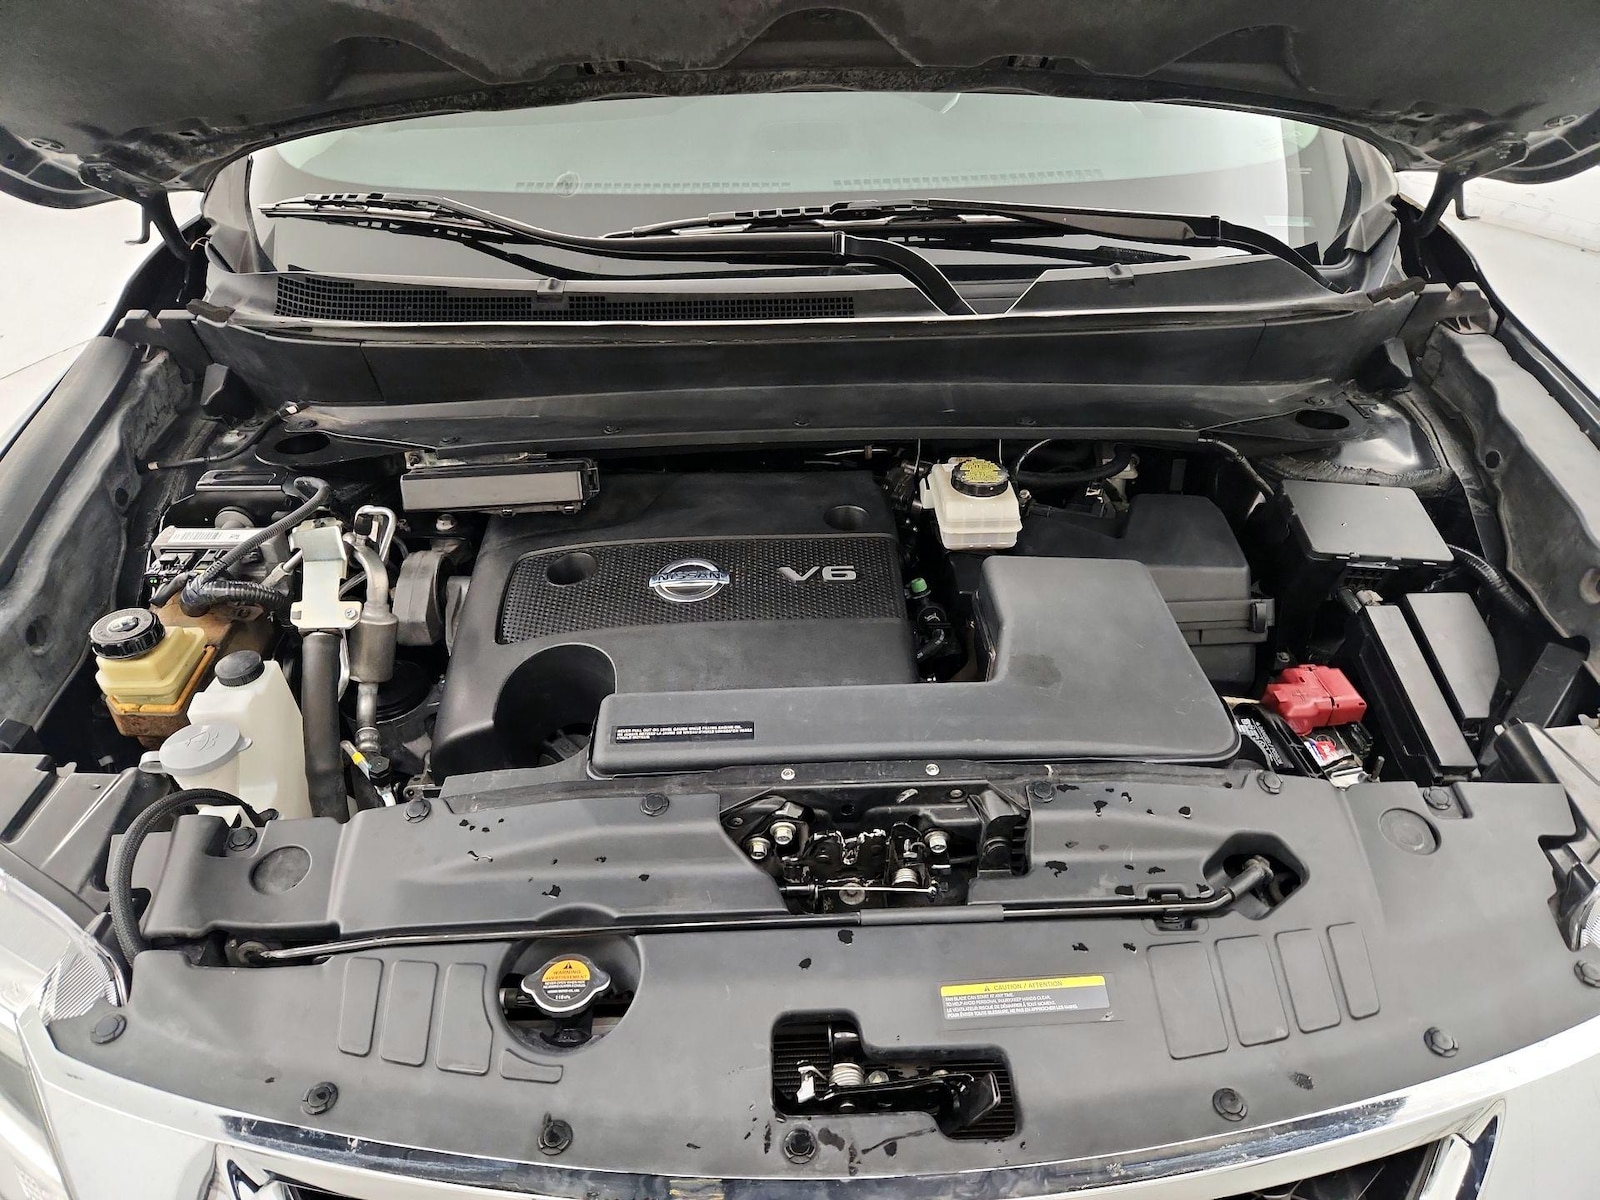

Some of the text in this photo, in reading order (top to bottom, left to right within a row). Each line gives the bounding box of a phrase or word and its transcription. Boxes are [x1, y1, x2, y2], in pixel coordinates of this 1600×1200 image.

[658, 570, 722, 582] NISSAN
[779, 565, 857, 583] V6
[994, 982, 1022, 991] CAUTION
[1028, 980, 1063, 988] ATTENTION
